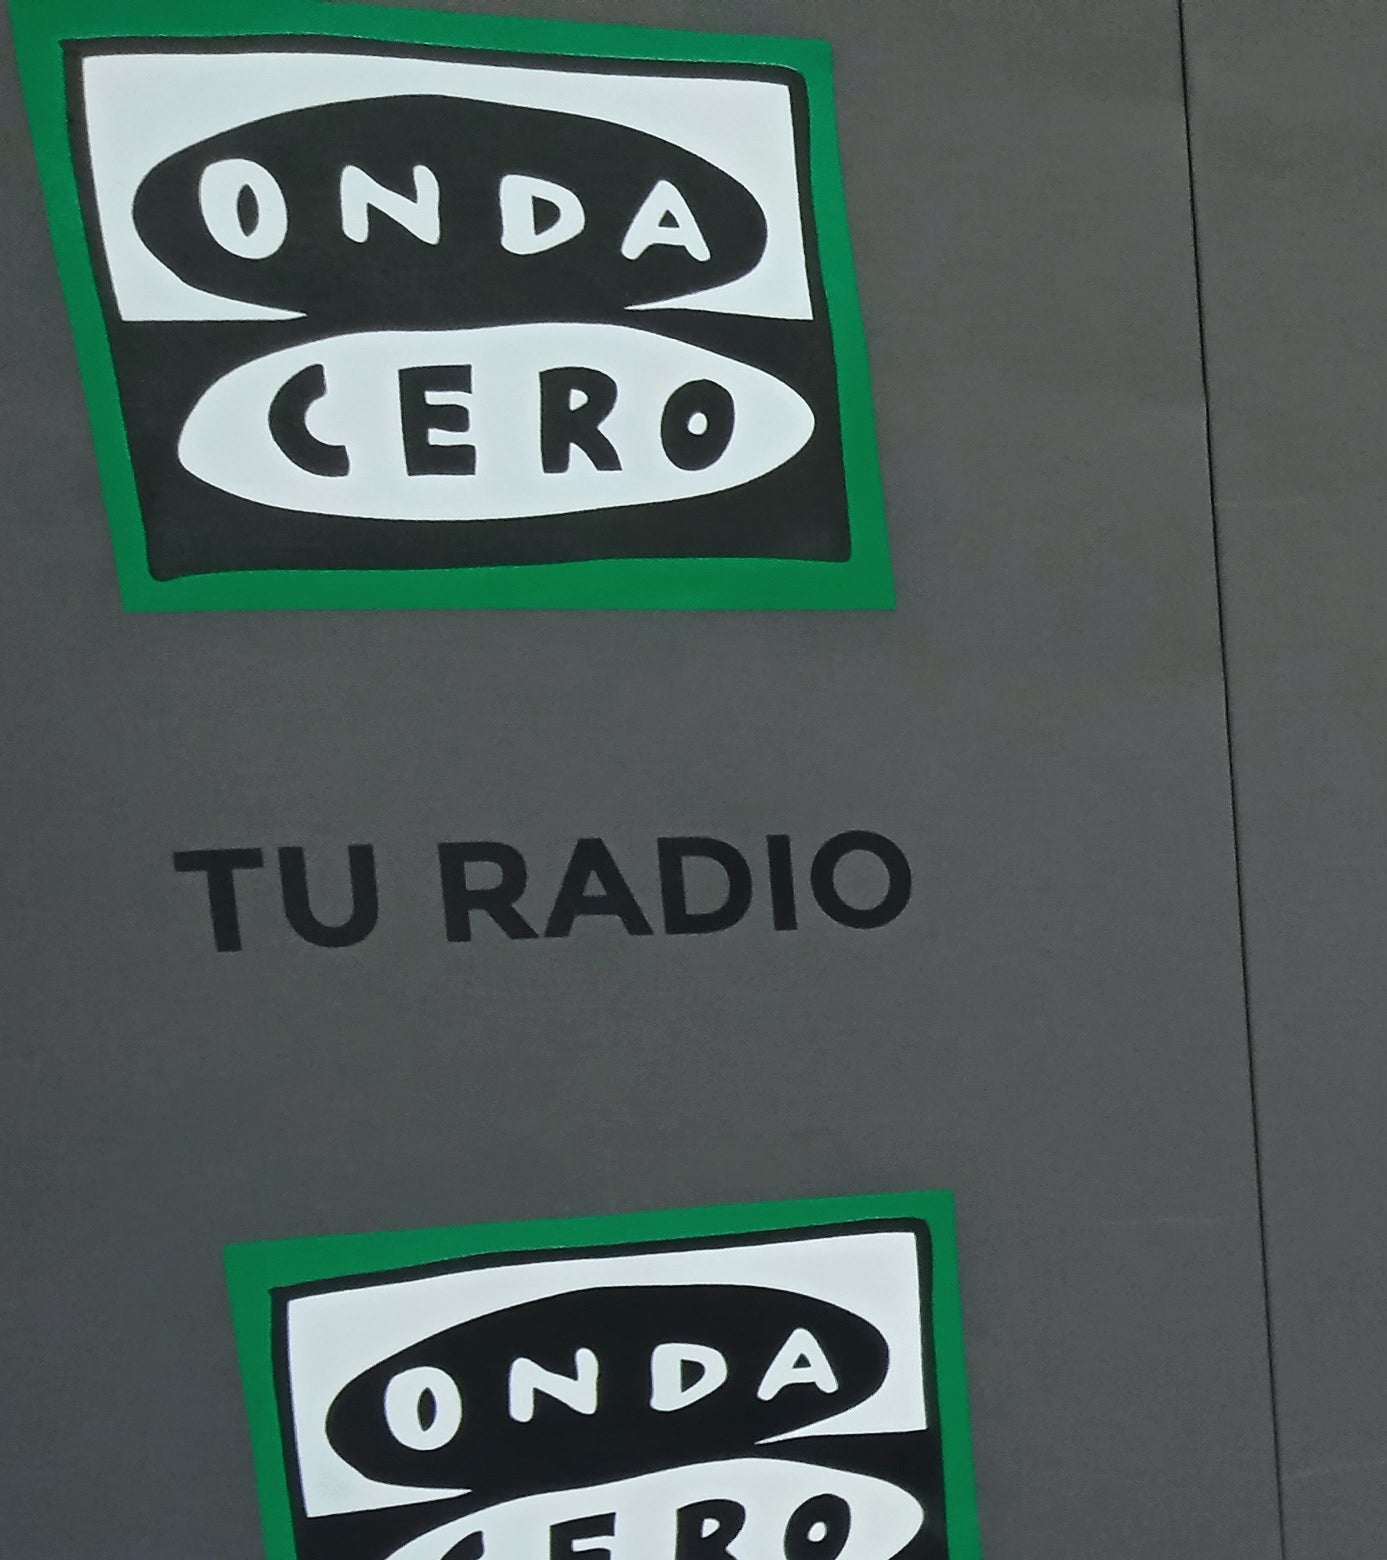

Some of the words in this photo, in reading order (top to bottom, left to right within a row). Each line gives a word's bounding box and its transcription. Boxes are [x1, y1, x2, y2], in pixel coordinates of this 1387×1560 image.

[200, 158, 711, 262] ONDA
[268, 364, 736, 477] CERO
[173, 843, 380, 952] TU
[437, 830, 912, 943] RADIO
[384, 1328, 838, 1450] ONDA
